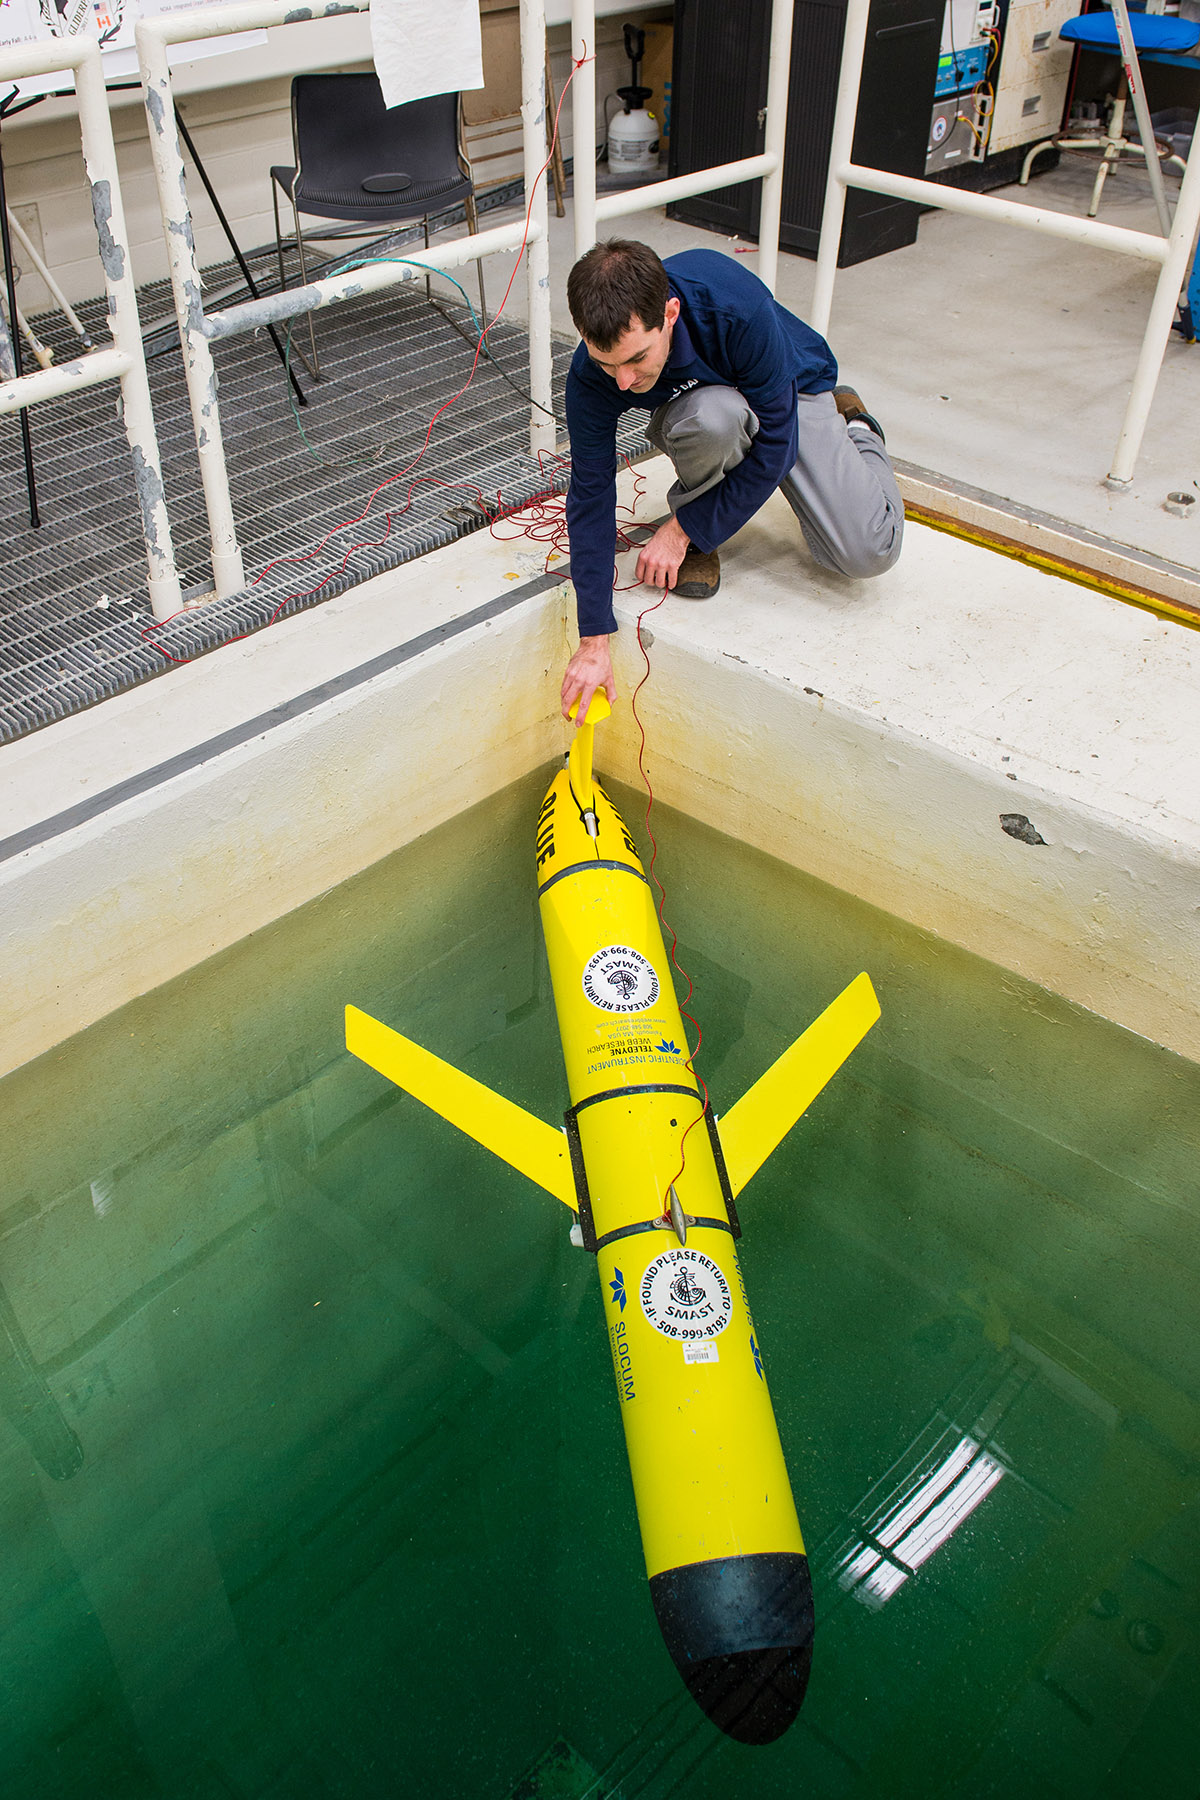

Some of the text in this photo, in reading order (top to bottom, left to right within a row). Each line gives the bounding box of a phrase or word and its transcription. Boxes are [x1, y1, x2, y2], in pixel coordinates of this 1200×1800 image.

[588, 946, 647, 969] 508-999-8193
[600, 960, 641, 975] SMAST
[584, 968, 659, 1012] IF FOUND PLEASE RETURN TO
[587, 1040, 625, 1055] RESEARCH
[610, 1045, 653, 1057] TELEDYNE
[587, 1055, 646, 1075] INSTRUMENT
[642, 1250, 731, 1318] IF FOUND PLEASE RETURN TO
[664, 1302, 715, 1320] SMAST
[657, 1315, 727, 1339] 508-999-8193
[615, 1321, 636, 1401] SLOCUM
